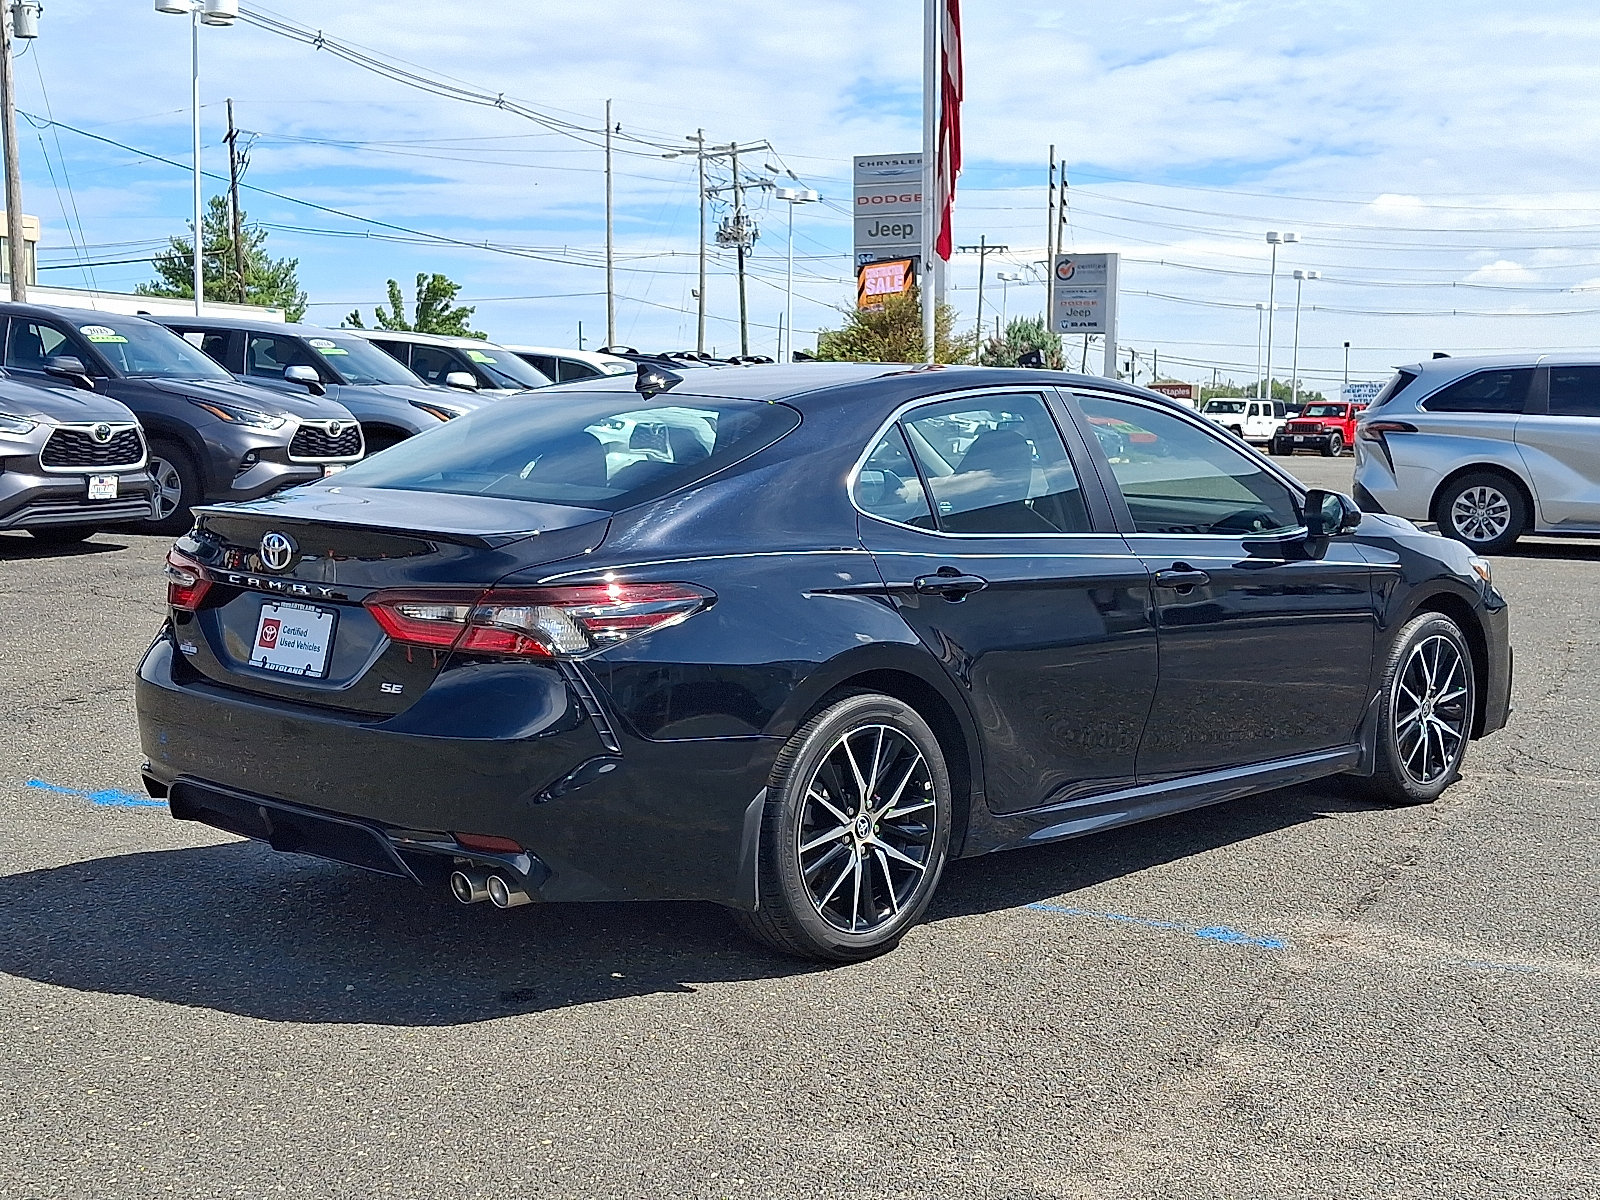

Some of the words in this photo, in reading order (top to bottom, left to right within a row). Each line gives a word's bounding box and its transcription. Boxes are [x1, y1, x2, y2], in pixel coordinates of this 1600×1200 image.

[857, 193, 922, 205] DODGE
[868, 221, 914, 239] Jeep
[865, 275, 904, 296] SALE
[1066, 308, 1091, 318] Jeep
[1161, 388, 1190, 397] Staples
[228, 574, 333, 598] CAMRY
[282, 625, 309, 638] Certified
[279, 637, 296, 648] Used
[296, 639, 321, 653] Vehicles
[264, 662, 304, 676] AUTOLAND
[379, 682, 404, 694] SE
